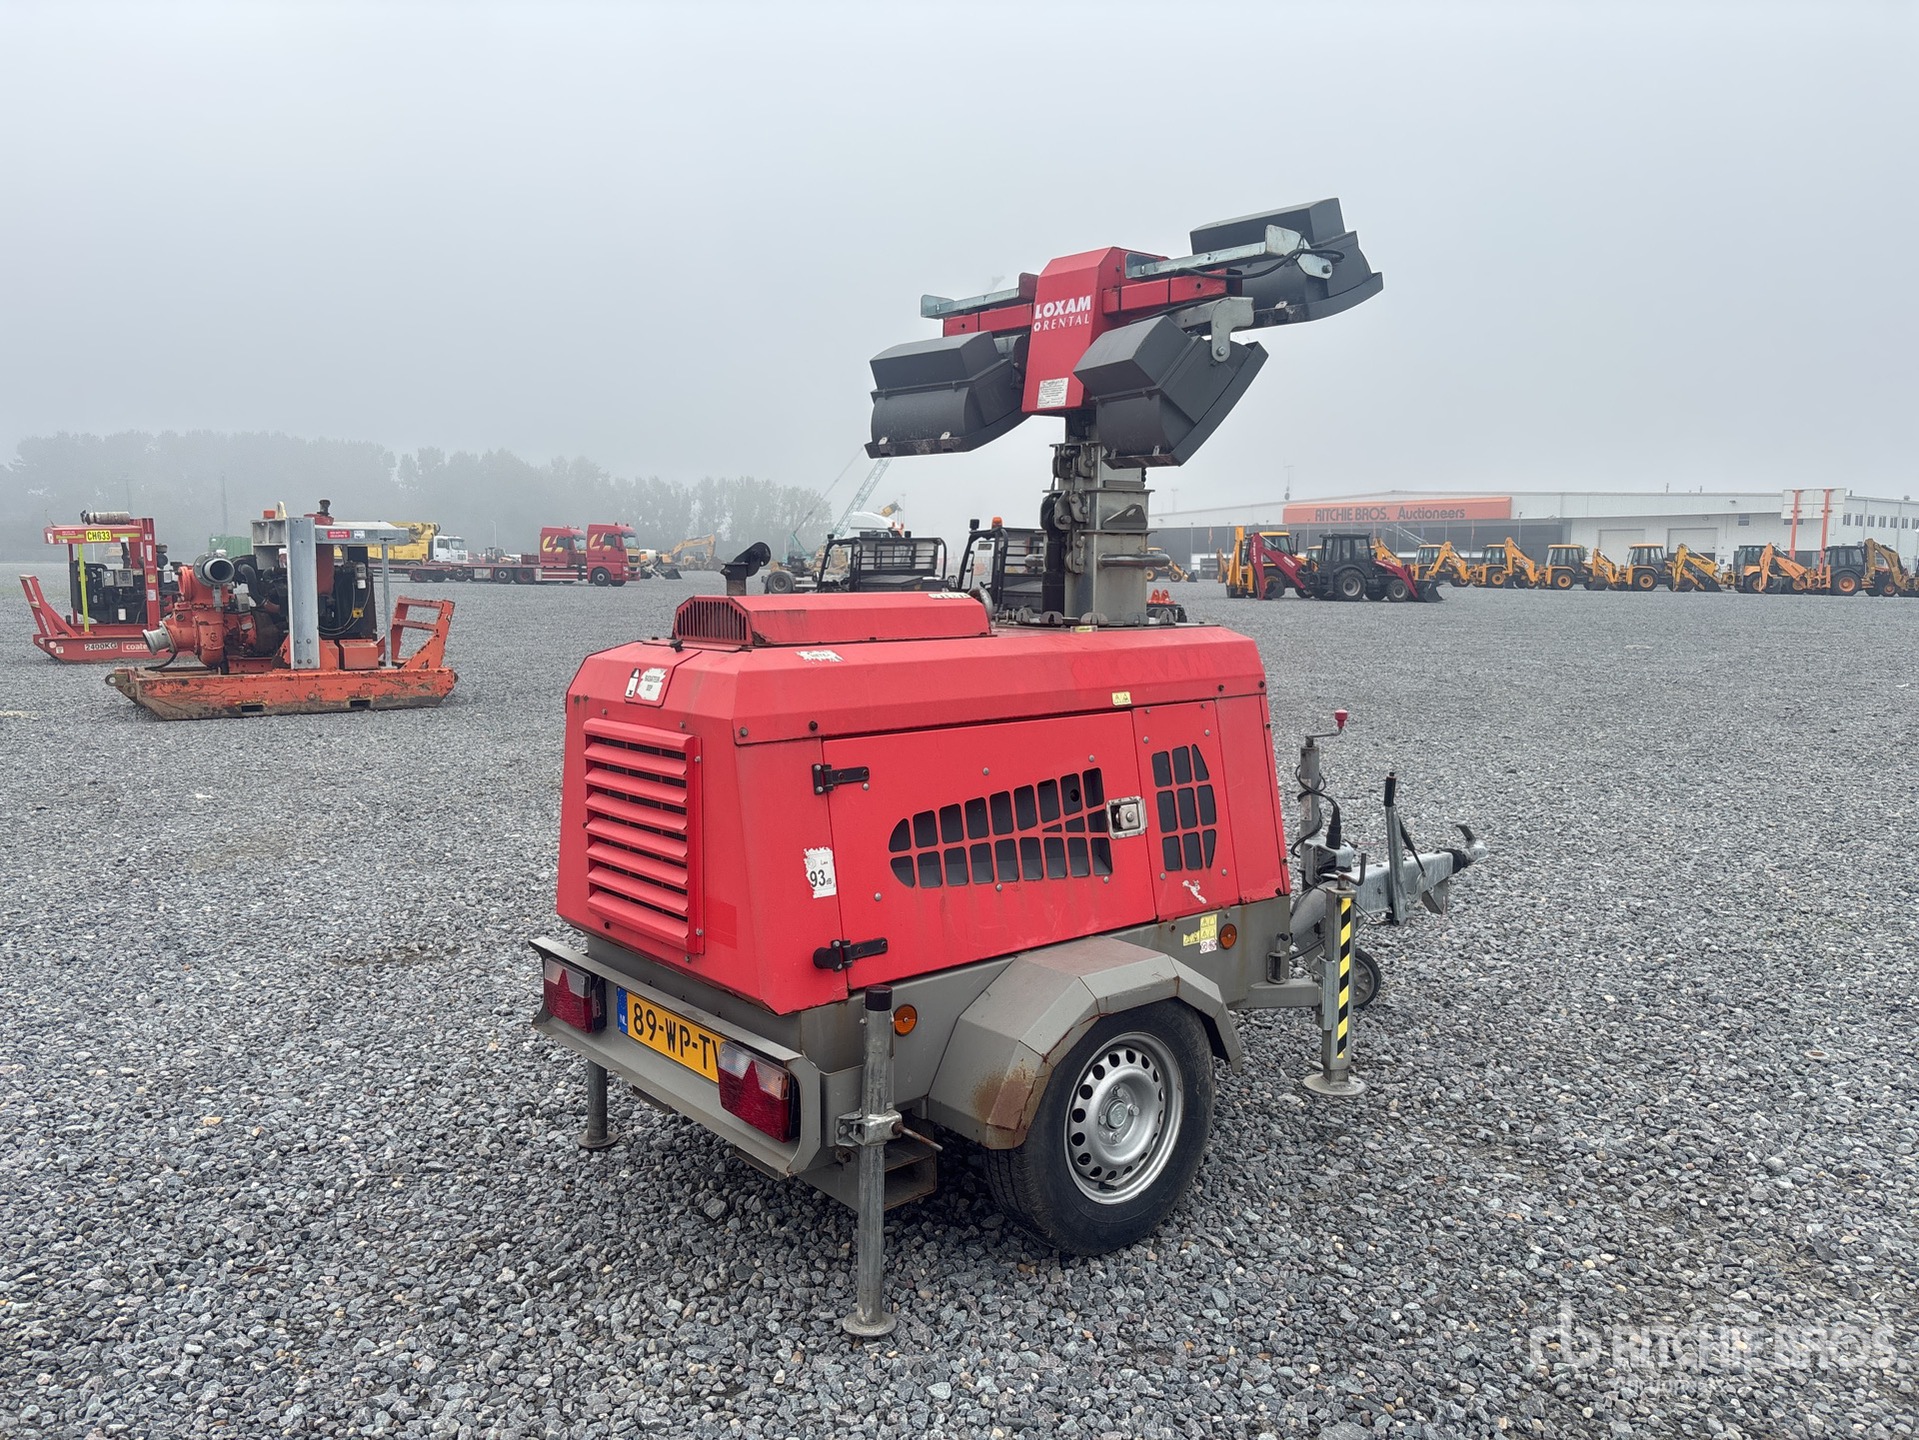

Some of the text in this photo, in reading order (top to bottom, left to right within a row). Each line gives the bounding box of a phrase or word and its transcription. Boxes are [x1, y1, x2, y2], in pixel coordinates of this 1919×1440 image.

[1034, 295, 1092, 320] LOXAM
[1043, 313, 1090, 331] RENTAL
[1315, 507, 1353, 522] RITCHIE
[1397, 508, 1465, 520] Auctioneers
[85, 642, 118, 651] 2400KG
[125, 642, 148, 651] coate
[810, 869, 826, 888] 93
[620, 1013, 627, 1026] NL
[633, 1002, 719, 1073] 89-WP-T
